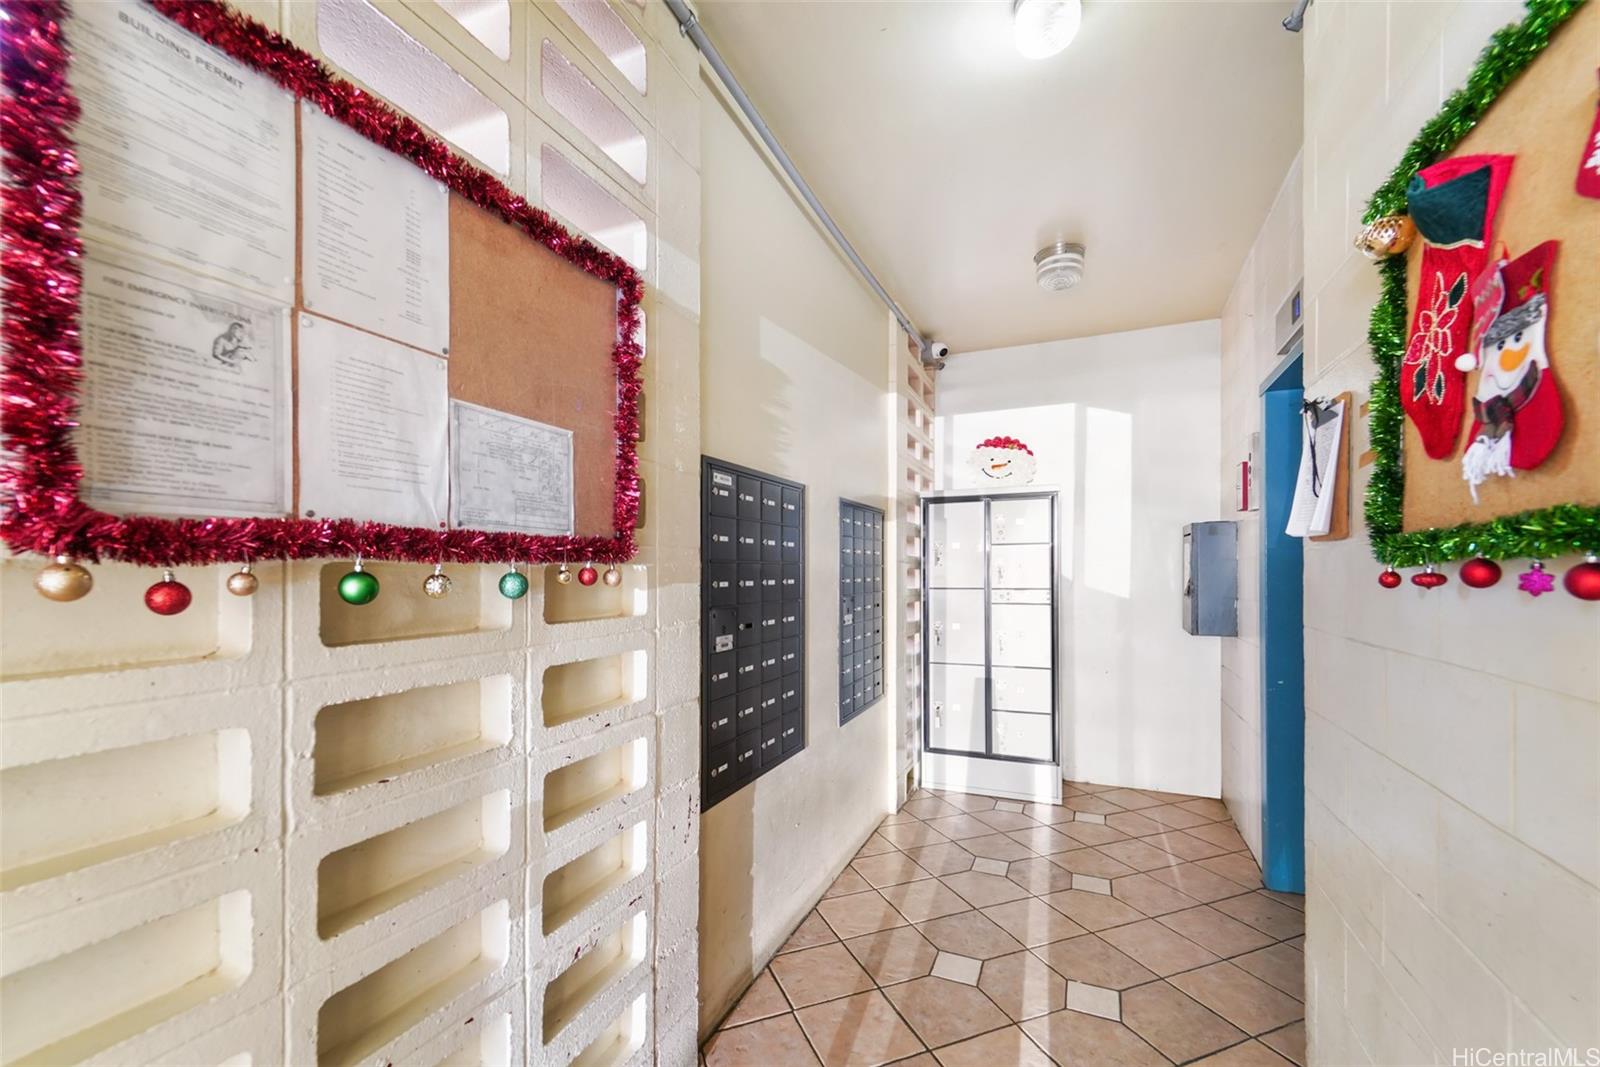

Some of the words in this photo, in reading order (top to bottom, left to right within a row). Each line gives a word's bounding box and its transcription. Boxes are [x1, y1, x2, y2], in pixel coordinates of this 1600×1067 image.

[118, 11, 191, 60] BUILDING
[195, 56, 245, 89] PERMIT
[127, 283, 186, 304] EMERGENCY
